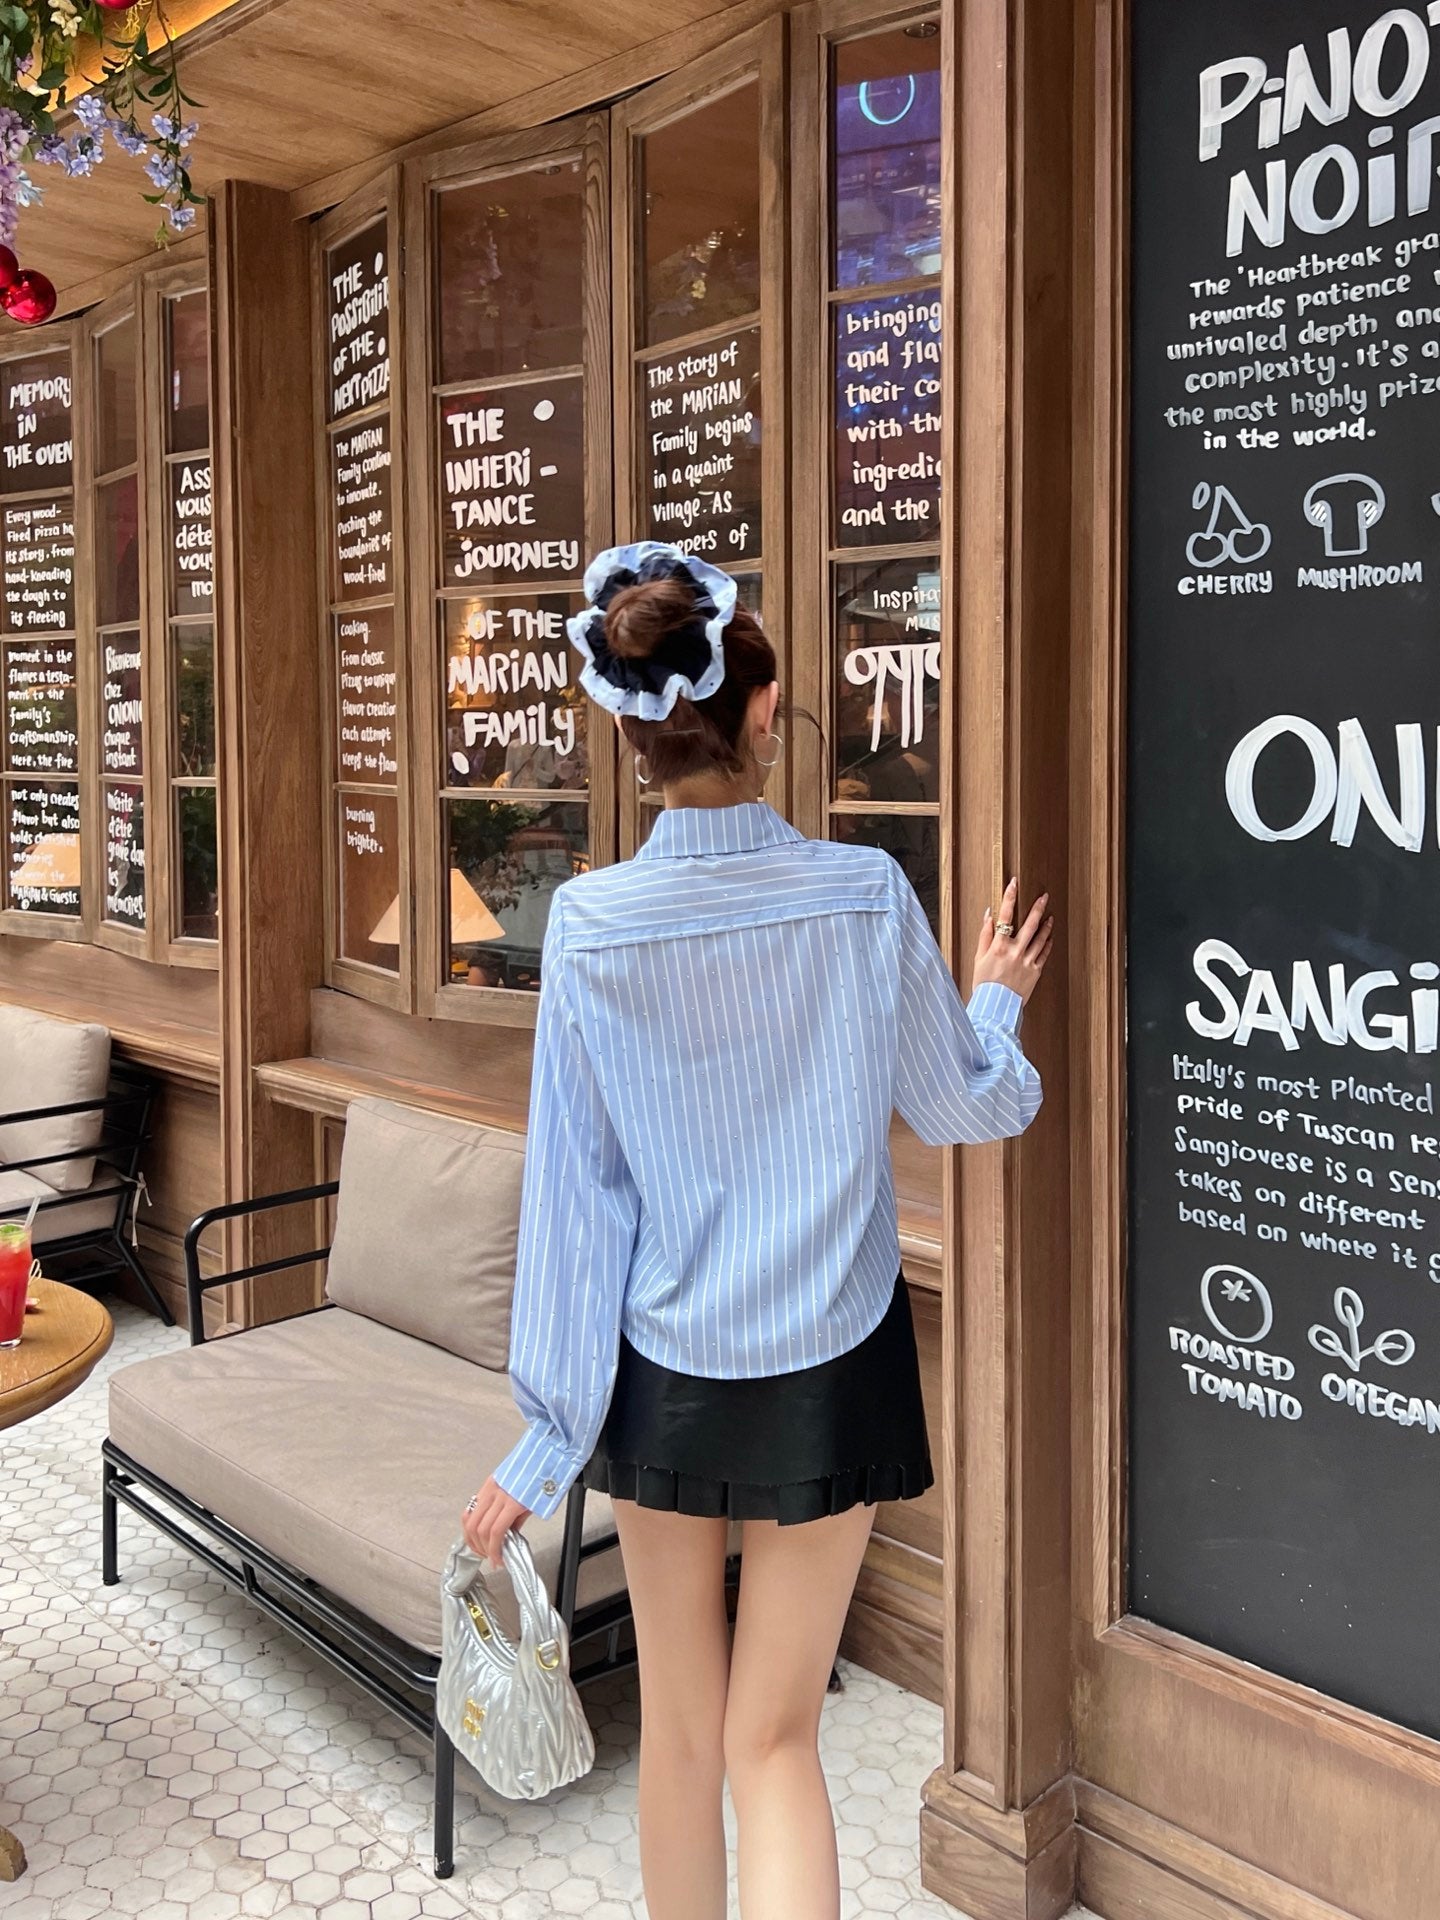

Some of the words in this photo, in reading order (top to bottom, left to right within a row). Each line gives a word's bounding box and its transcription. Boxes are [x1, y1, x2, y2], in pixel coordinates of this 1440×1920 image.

[1198, 0, 1440, 162] PiNO
[1190, 278, 1230, 298] The
[1395, 233, 1440, 267] gra
[333, 262, 363, 303] THE
[1190, 295, 1286, 329] rewards
[1297, 274, 1411, 317] patience
[847, 302, 941, 337] bringing
[1166, 324, 1286, 360] unrivaled
[1298, 313, 1378, 346] depth
[333, 347, 348, 376] OF
[350, 331, 374, 364] THE
[648, 366, 674, 388] The
[720, 340, 738, 367] of
[847, 342, 889, 372] and
[900, 340, 942, 369] fla
[1357, 340, 1408, 367] It's
[334, 372, 362, 415] NEXT
[650, 397, 672, 419] the
[844, 381, 905, 408] their
[1164, 406, 1205, 428] the
[1214, 394, 1278, 422] most
[1291, 384, 1367, 417] highly
[1379, 373, 1440, 408] priz
[446, 408, 504, 448] THE
[652, 425, 698, 456] Family
[705, 412, 753, 447] begins
[847, 418, 902, 443] with
[910, 413, 942, 434] th
[1203, 430, 1226, 450] in
[1236, 428, 1280, 448] the
[1292, 416, 1376, 446] world.
[3, 443, 32, 469] THE
[35, 440, 73, 466] OVEN
[336, 442, 348, 458] The
[337, 462, 361, 484] Family
[653, 469, 667, 490] in
[672, 467, 682, 484] a
[684, 453, 734, 488] quaint
[336, 494, 345, 506] to
[451, 494, 536, 530] TANCE
[842, 502, 886, 526] and
[890, 498, 930, 521] the
[368, 510, 382, 526] the
[34, 525, 60, 542] pizza
[382, 532, 392, 551] of
[729, 522, 749, 551] of
[51, 544, 74, 558] from
[178, 552, 213, 572] vou
[1177, 570, 1272, 595] CHERRY
[1297, 561, 1422, 592] MUSHROOM
[6, 590, 20, 603] the
[22, 590, 50, 608] dough
[52, 589, 66, 601] to
[873, 586, 940, 612] Inspira
[26, 610, 66, 628] fleeting
[468, 610, 503, 640] OF
[507, 608, 563, 640] THE
[44, 650, 54, 663] in
[56, 649, 72, 664] the
[342, 650, 360, 668] From
[32, 690, 44, 701] to
[47, 689, 64, 701] the
[364, 676, 372, 687] to
[342, 698, 365, 716] flavor
[342, 726, 358, 742] each
[361, 726, 392, 747] attempt
[37, 754, 52, 768] the
[364, 754, 378, 768] the
[11, 788, 28, 802] not
[30, 788, 48, 808] only
[1225, 714, 1440, 853] ON
[12, 810, 39, 827] flavor
[42, 809, 58, 827] but
[62, 814, 80, 830] also
[10, 829, 33, 844] holds
[1172, 1054, 1246, 1090] Italy's
[1257, 1076, 1320, 1100] most
[1257, 1108, 1289, 1132] of
[1297, 1112, 1394, 1150] Tuscan
[1410, 1134, 1440, 1160] re
[1174, 1126, 1314, 1174] Sangiovese
[1325, 1157, 1348, 1183] is
[1356, 1167, 1374, 1188] a
[1175, 1168, 1242, 1203] takes
[1255, 1187, 1286, 1208] on
[1300, 1192, 1426, 1230] different
[1178, 1202, 1247, 1236] based
[1257, 1224, 1288, 1242] on
[1300, 1231, 1377, 1260] where
[1391, 1242, 1418, 1269] it
[1169, 1326, 1295, 1381] ROASTED
[1181, 1363, 1303, 1420] TOMATO
